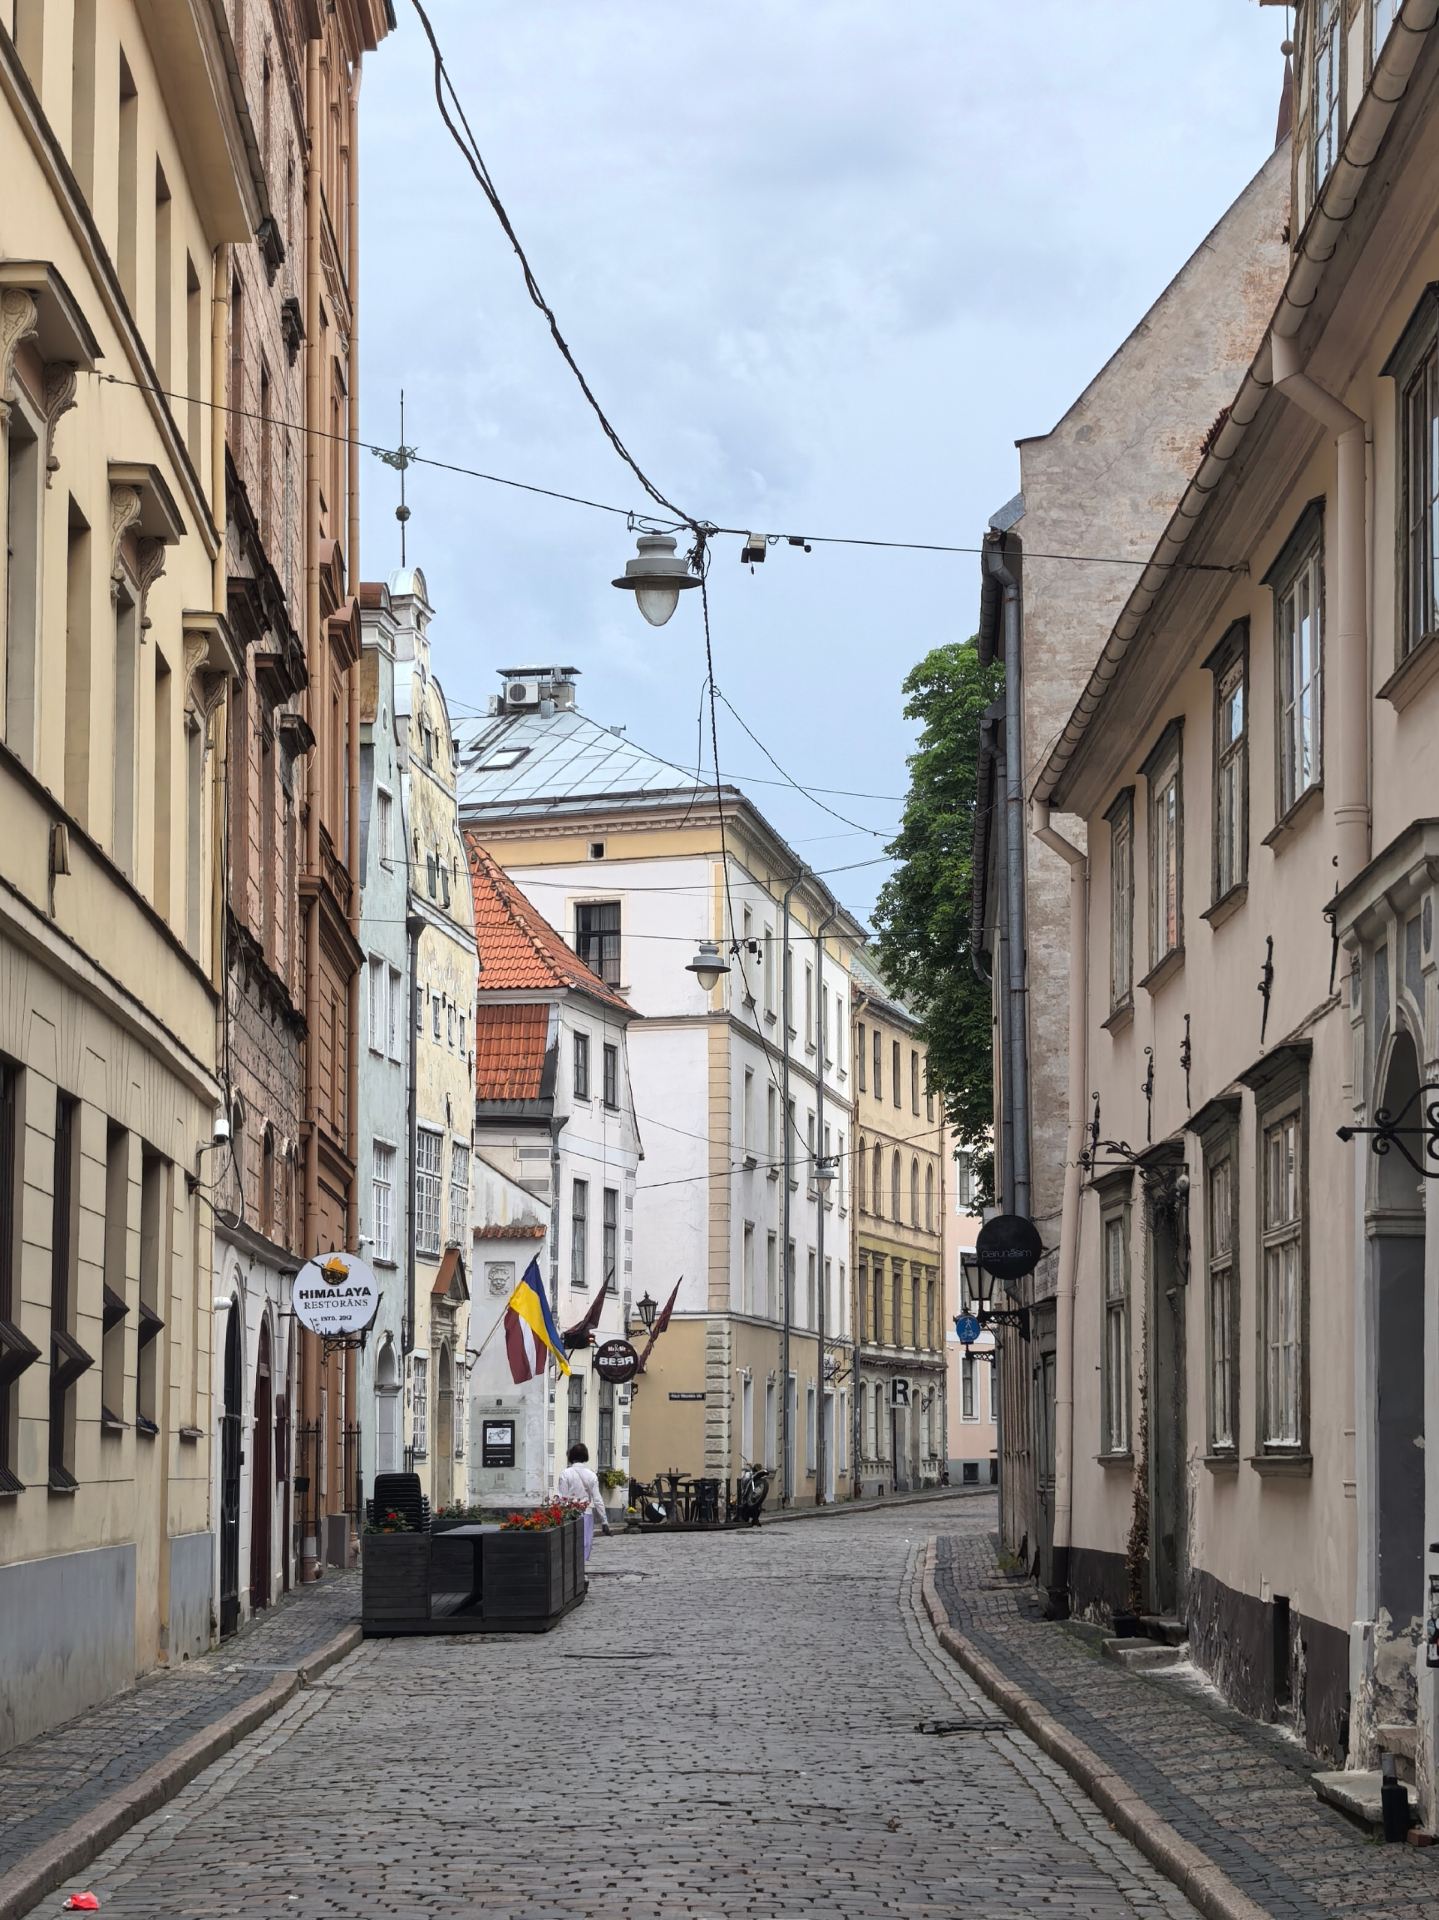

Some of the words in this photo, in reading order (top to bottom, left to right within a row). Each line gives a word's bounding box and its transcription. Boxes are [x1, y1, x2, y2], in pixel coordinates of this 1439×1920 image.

[299, 1286, 371, 1300] HIMALAYA
[304, 1299, 368, 1310] RESTORĀNS
[892, 1378, 910, 1405] R
